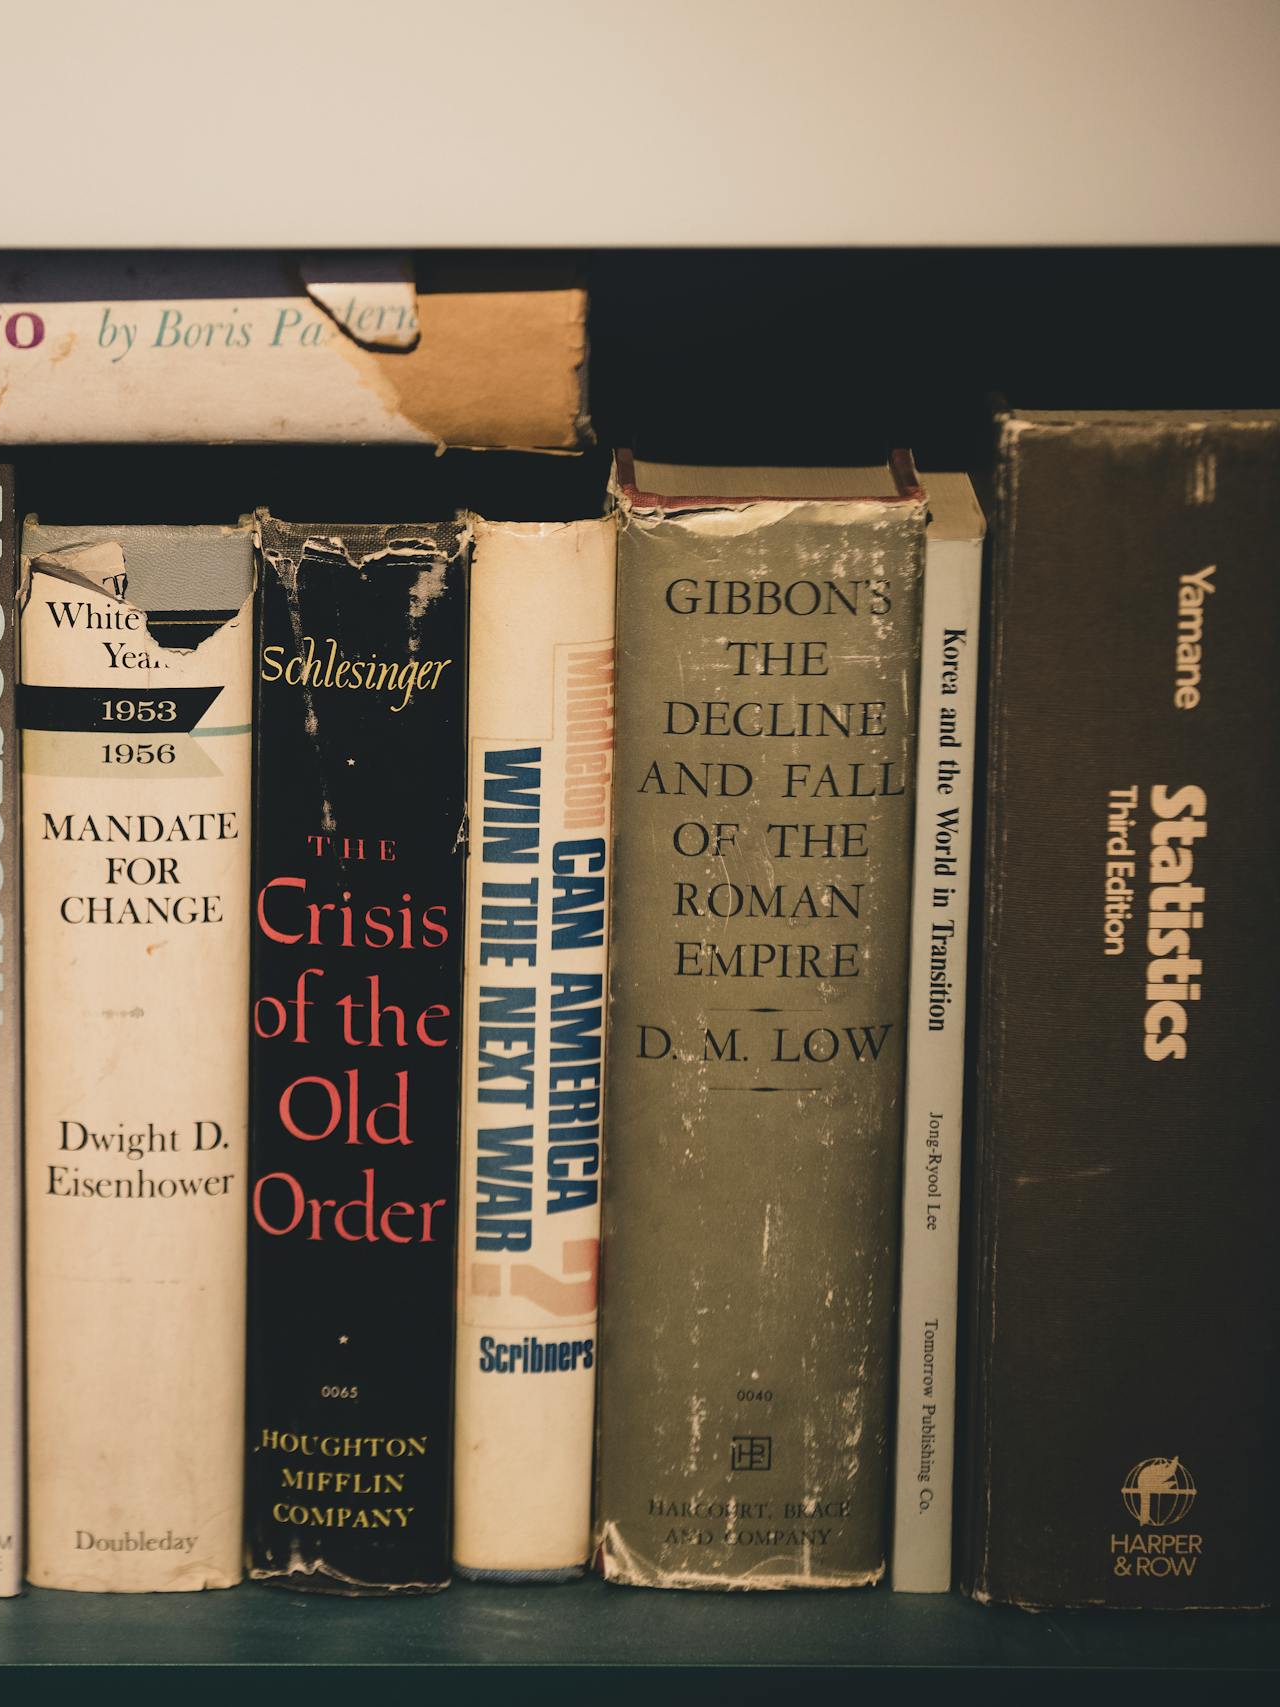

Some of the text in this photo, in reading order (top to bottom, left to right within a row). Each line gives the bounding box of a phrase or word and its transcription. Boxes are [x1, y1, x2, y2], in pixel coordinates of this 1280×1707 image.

[98, 308, 137, 363] by
[151, 307, 253, 348] Boris
[45, 601, 140, 631] White
[665, 577, 893, 617] GIBBON'S
[1174, 564, 1217, 711] Yamane
[261, 636, 452, 712] Schlesinger
[726, 640, 830, 677] THE
[101, 700, 178, 723] 1953
[663, 700, 887, 737] DECLINE
[101, 744, 177, 765] 1956
[563, 648, 616, 829] Middleton
[636, 760, 906, 799] AND FALL
[482, 746, 542, 865] WIN
[42, 811, 239, 842] MANDATE
[672, 821, 870, 859] OF THE
[927, 628, 967, 1033] Korea and the World in Transition
[307, 835, 397, 862] THE
[105, 857, 180, 885] FOR
[1103, 785, 1139, 956] Third Edition
[60, 895, 224, 925] CHANGE
[257, 876, 449, 950] Crisis
[672, 882, 866, 920] ROMAN
[479, 876, 539, 969] THE
[1143, 783, 1208, 1062] Statistics
[674, 941, 860, 979] EMPIRE
[254, 969, 450, 1048] of the
[546, 837, 606, 1215] CAN AMERICA
[477, 985, 536, 1111] NEXT
[636, 1024, 895, 1064] D. M. LOW
[278, 1070, 414, 1146] Old
[58, 1119, 229, 1161] Dwight D.
[47, 1166, 236, 1199] Eisenhower
[925, 1111, 944, 1231] Jong-Ryool Lee
[252, 1168, 447, 1244] Order
[479, 1335, 594, 1375] Scribners
[321, 1386, 358, 1398] 0065
[736, 1390, 774, 1401] 0040
[918, 1319, 939, 1515] Tomorrow Publishing Co.
[262, 1429, 428, 1457] HOUGHTON
[280, 1468, 405, 1493] MIFFLIN
[273, 1503, 414, 1528] COMPANY
[74, 1530, 198, 1555] Doubleday
[1111, 1534, 1203, 1555] HARPER
[1114, 1556, 1198, 1577] & ROW
